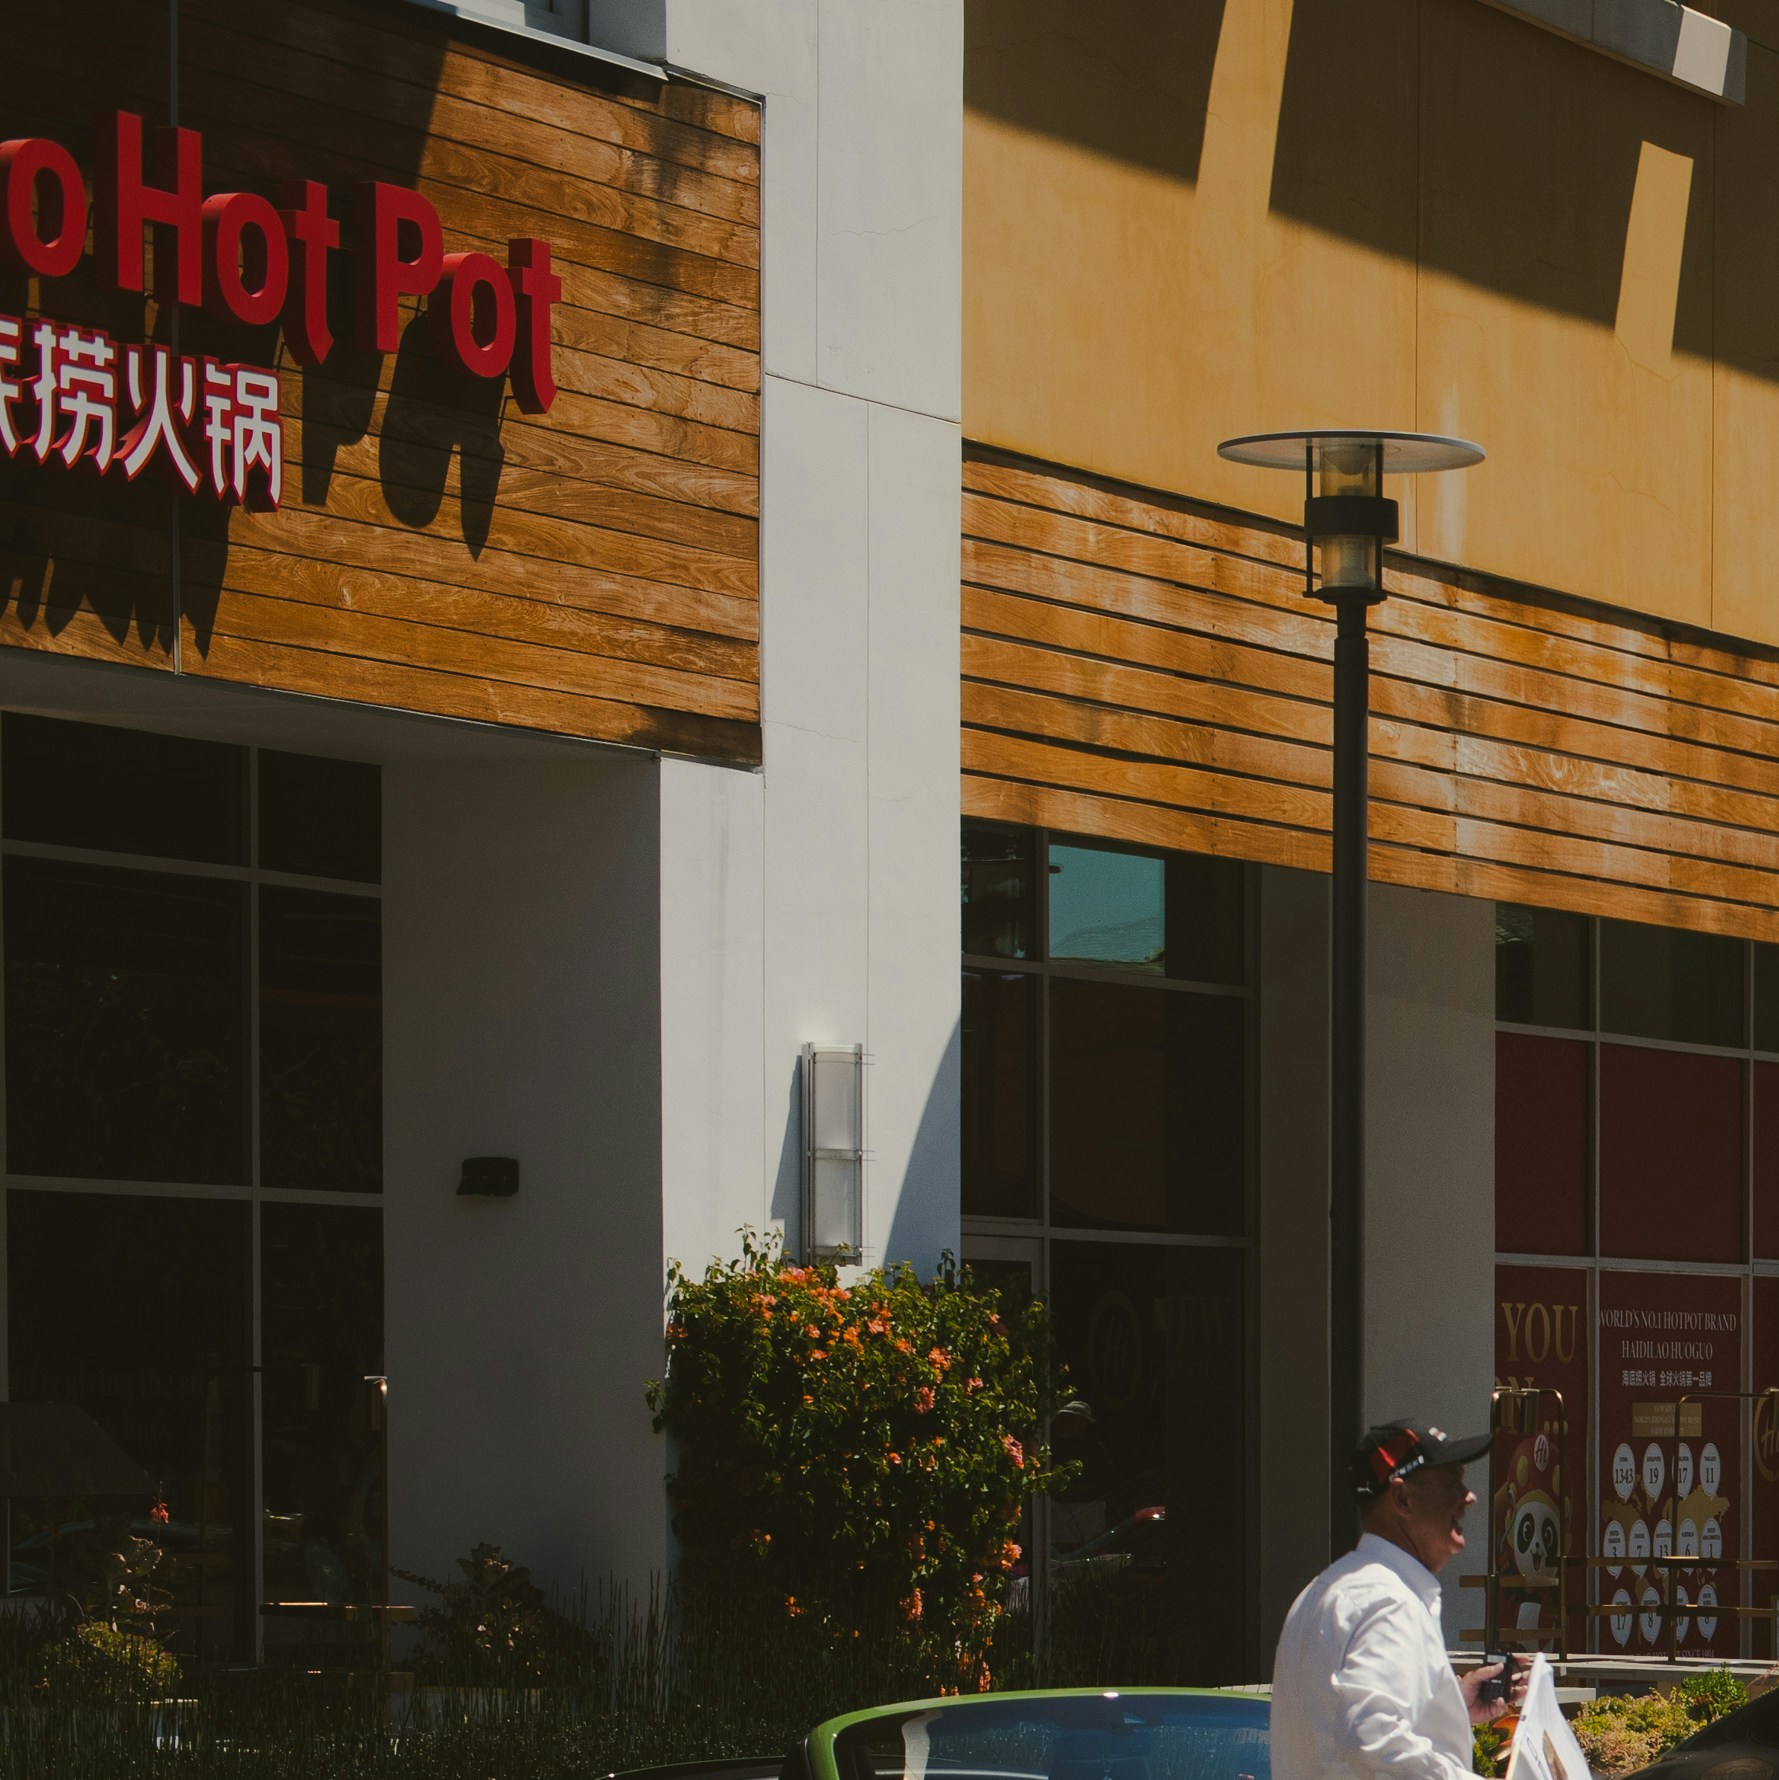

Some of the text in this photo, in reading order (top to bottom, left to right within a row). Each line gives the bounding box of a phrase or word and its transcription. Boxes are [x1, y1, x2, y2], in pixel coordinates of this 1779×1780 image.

[115, 110, 340, 365] Hot
[360, 180, 562, 414] Pot
[1664, 1311, 1704, 1330] HOTPOT
[1705, 1313, 1737, 1332] BRAND
[1500, 1302, 1578, 1364] YOU
[1622, 1340, 1713, 1360] HAIDILAO HUOGUO
[1615, 1468, 1634, 1484] 1343
[1649, 1468, 1659, 1484] 19
[1678, 1468, 1688, 1484] 17
[1706, 1468, 1715, 1484] 11
